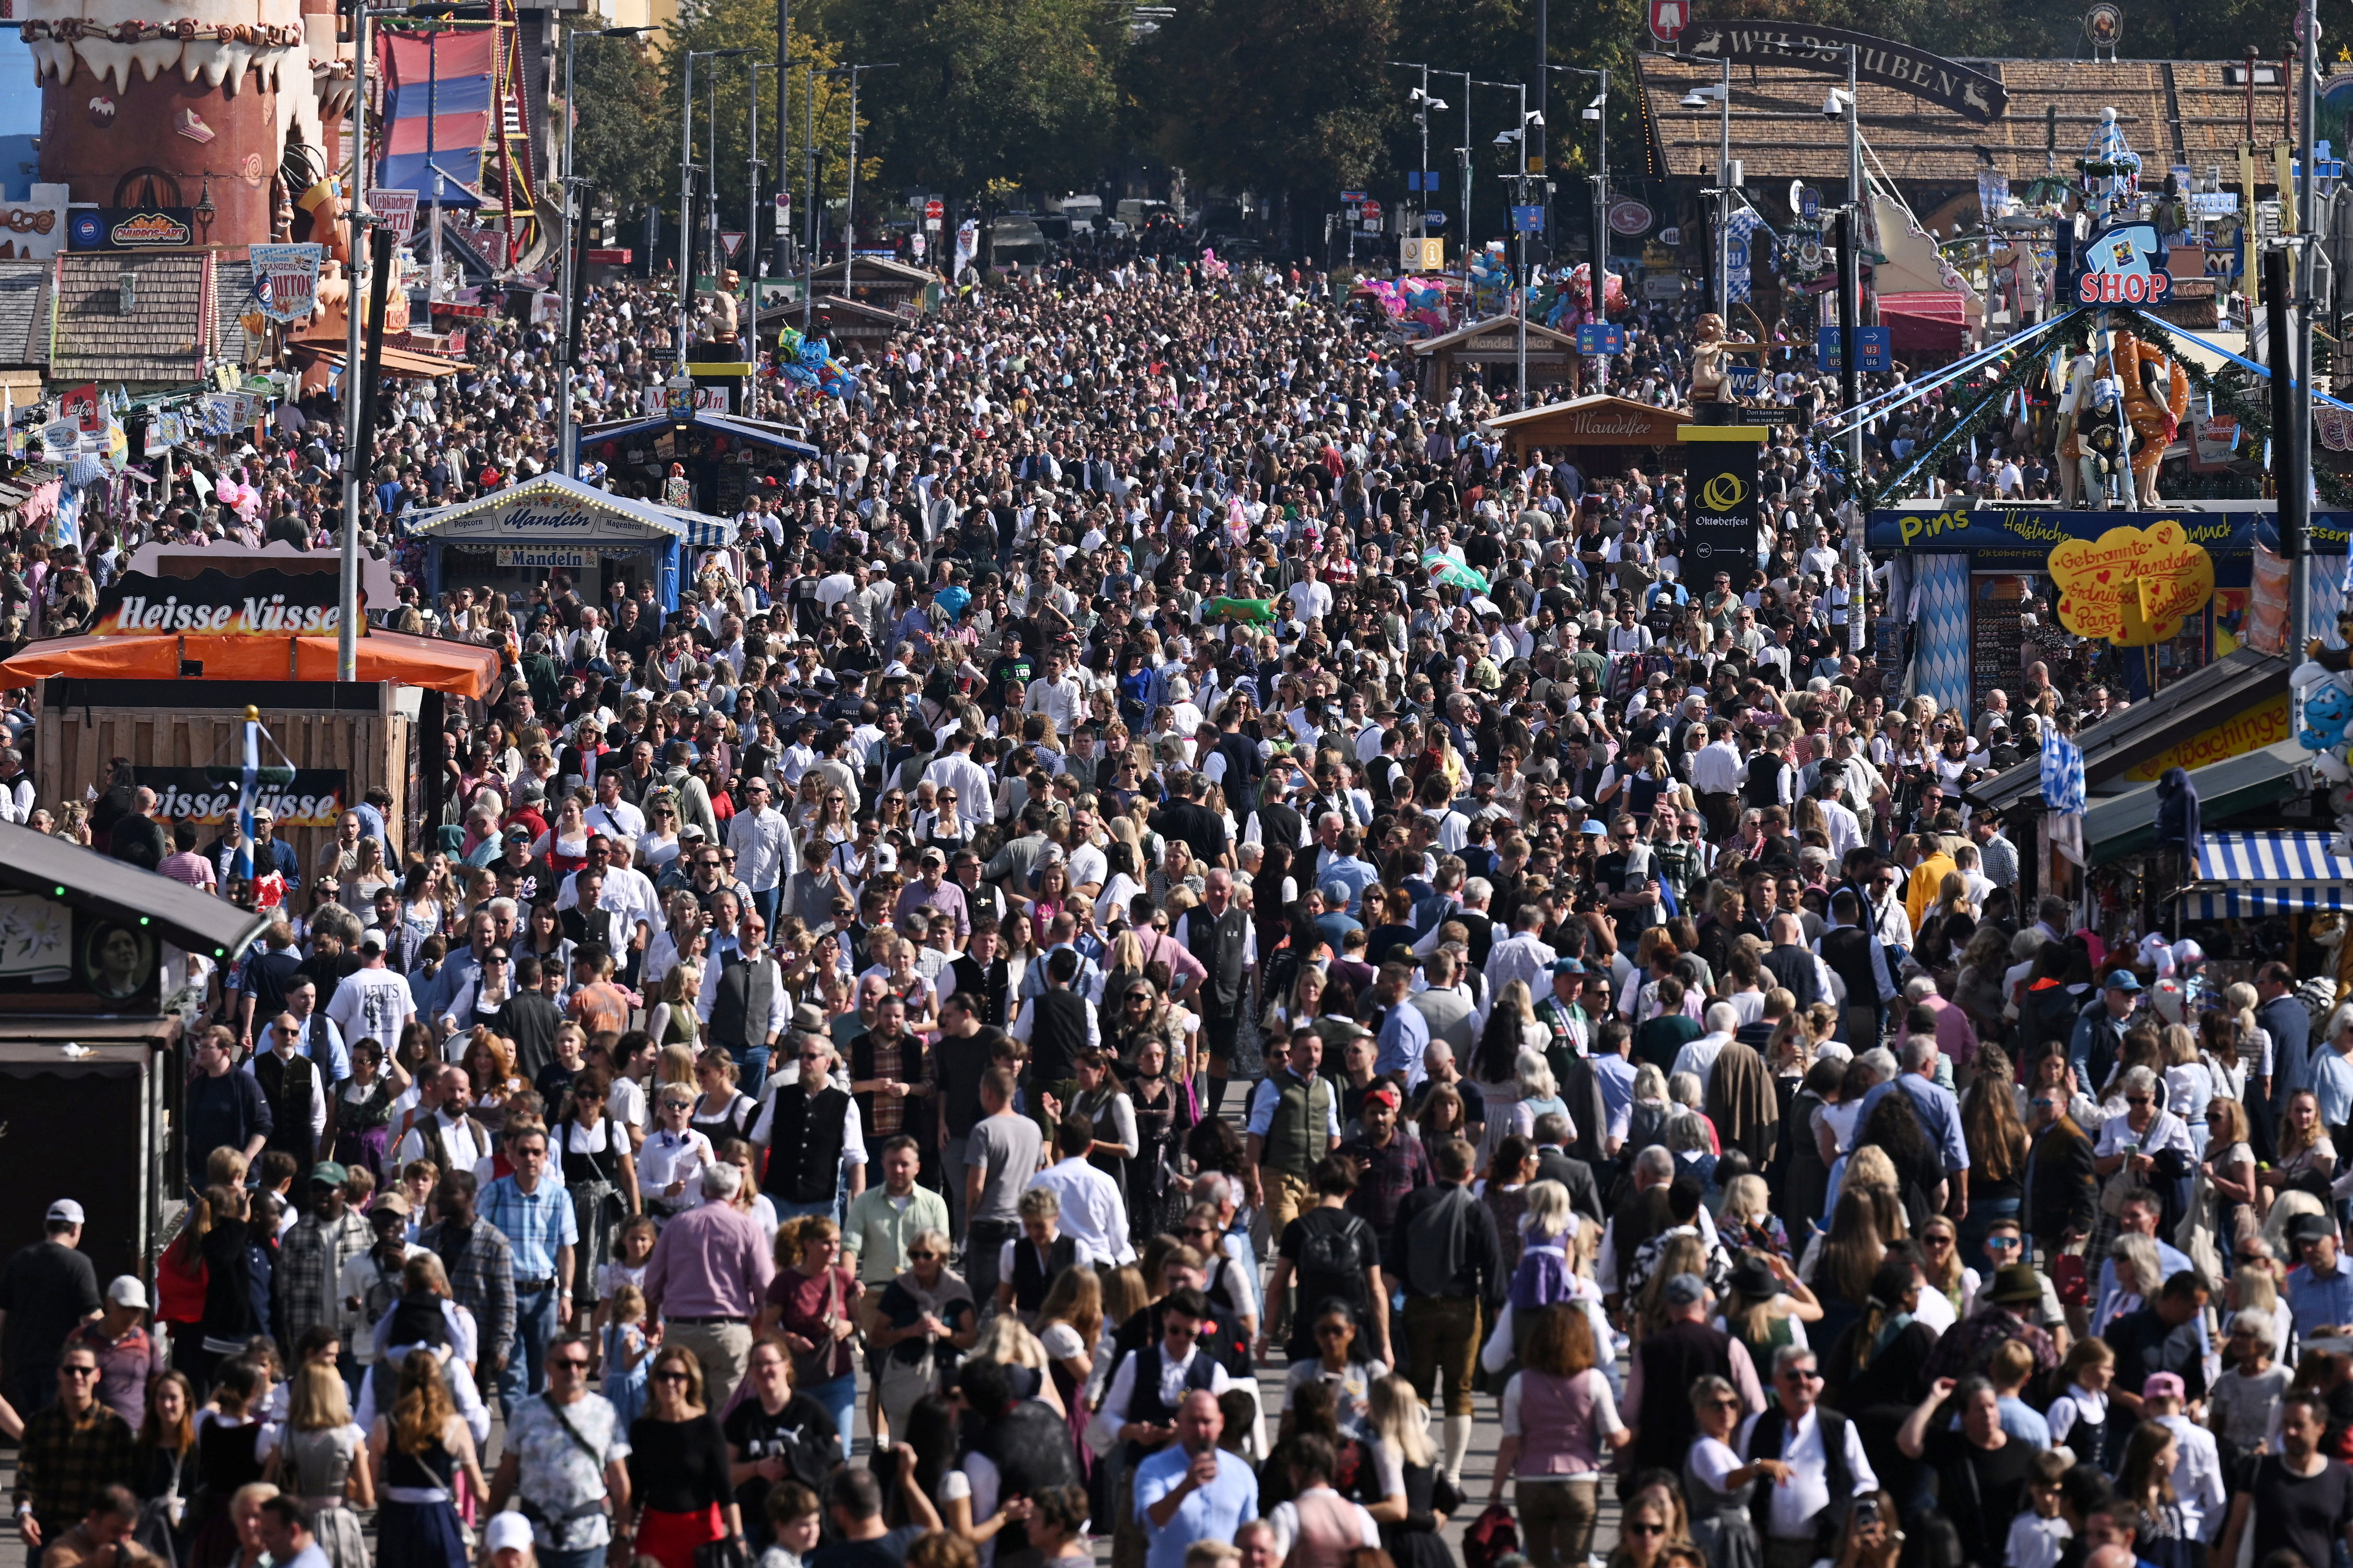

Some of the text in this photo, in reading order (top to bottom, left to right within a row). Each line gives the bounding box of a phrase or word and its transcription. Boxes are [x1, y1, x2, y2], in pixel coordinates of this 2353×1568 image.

[374, 196, 413, 210] Lebkuchen
[1805, 203, 1815, 214] HB
[261, 288, 271, 298] PEPS
[2080, 273, 2167, 303] SHOP
[1468, 336, 1552, 348] Mandel Max
[1731, 374, 1756, 390] WC
[650, 391, 724, 409] Mdeln
[1570, 411, 1651, 437] Mandelfee
[2091, 424, 2116, 437] Oktoberfest
[454, 519, 483, 528] Popcorn
[504, 508, 590, 529] Mandeln
[606, 520, 642, 531] Magenbrot
[1696, 516, 1748, 528] Oktoberfest
[1899, 510, 1969, 546] Pins
[511, 551, 582, 566] Mandeln
[2061, 540, 2148, 569] Gebrannte
[2124, 550, 2199, 577] Mandeln
[2069, 582, 2138, 604] Erdnüsse
[2147, 581, 2201, 617] Cashew
[118, 594, 340, 631] Heisse Nüsse
[2076, 606, 2121, 628] Para
[2173, 706, 2288, 767] Wachinge
[138, 784, 335, 819] eisse üsse
